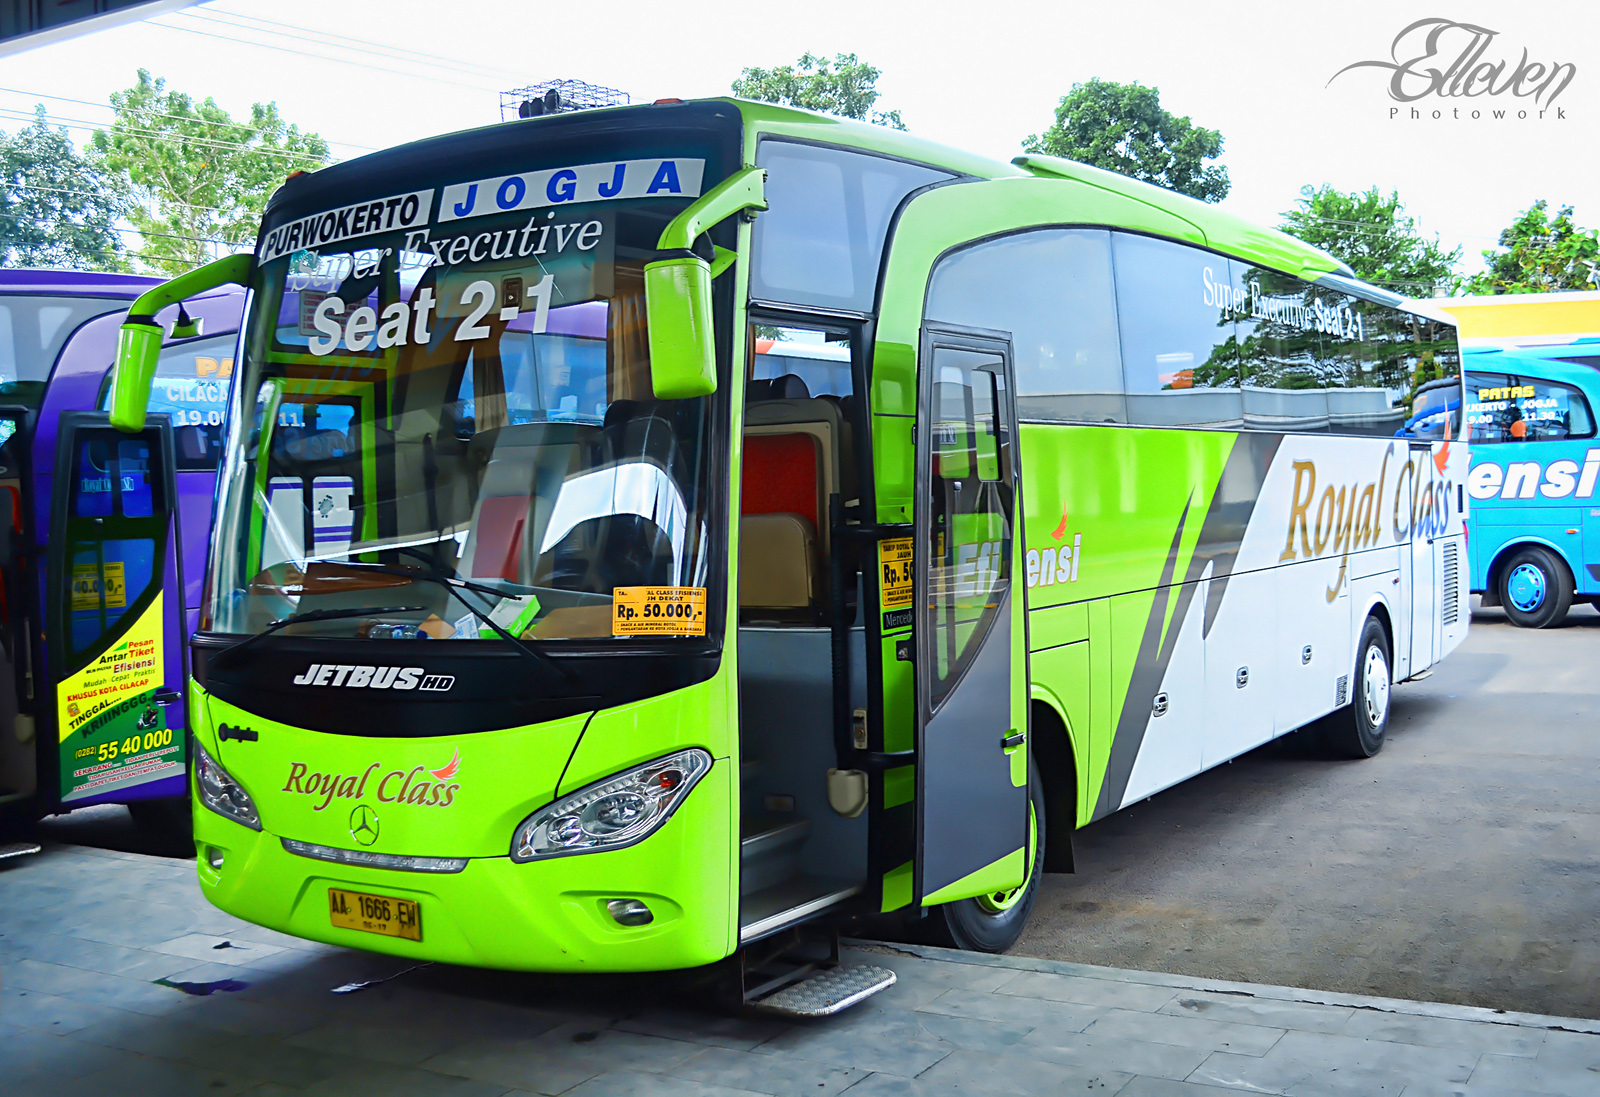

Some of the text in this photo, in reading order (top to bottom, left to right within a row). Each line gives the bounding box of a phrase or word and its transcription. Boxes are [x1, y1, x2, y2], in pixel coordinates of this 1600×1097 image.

[265, 161, 683, 253] PURWOKERTO JOGJA
[291, 211, 604, 296] Super Executive
[309, 286, 437, 356] Seat
[455, 274, 555, 342] 2-1
[1203, 266, 1364, 342] Super Executive Seat 2-1
[195, 356, 234, 378] PA
[166, 384, 230, 403] CILACA
[1478, 385, 1535, 401] PATAS
[1520, 398, 1558, 409] JOGJA
[1467, 411, 1556, 424] 9.00 11.30
[1467, 446, 1600, 501] ensi
[1279, 440, 1453, 604] Royal Class
[883, 563, 901, 588] Rp.
[617, 603, 703, 621] Rp. 50.000,-
[886, 611, 912, 627] Merced
[99, 647, 154, 664] Antar Tiket
[128, 639, 154, 649] Pesan
[113, 656, 156, 674] Efisiensi
[83, 668, 156, 688] Mudah Cepat Praktis
[293, 664, 454, 691] JETBUS HD
[67, 678, 149, 702] KHUSUS KOTA CILACAP
[75, 728, 173, 762] (0282) 55 40 000
[281, 761, 461, 812] Royal Class
[332, 892, 348, 915] AA
[358, 896, 391, 921] 1666
